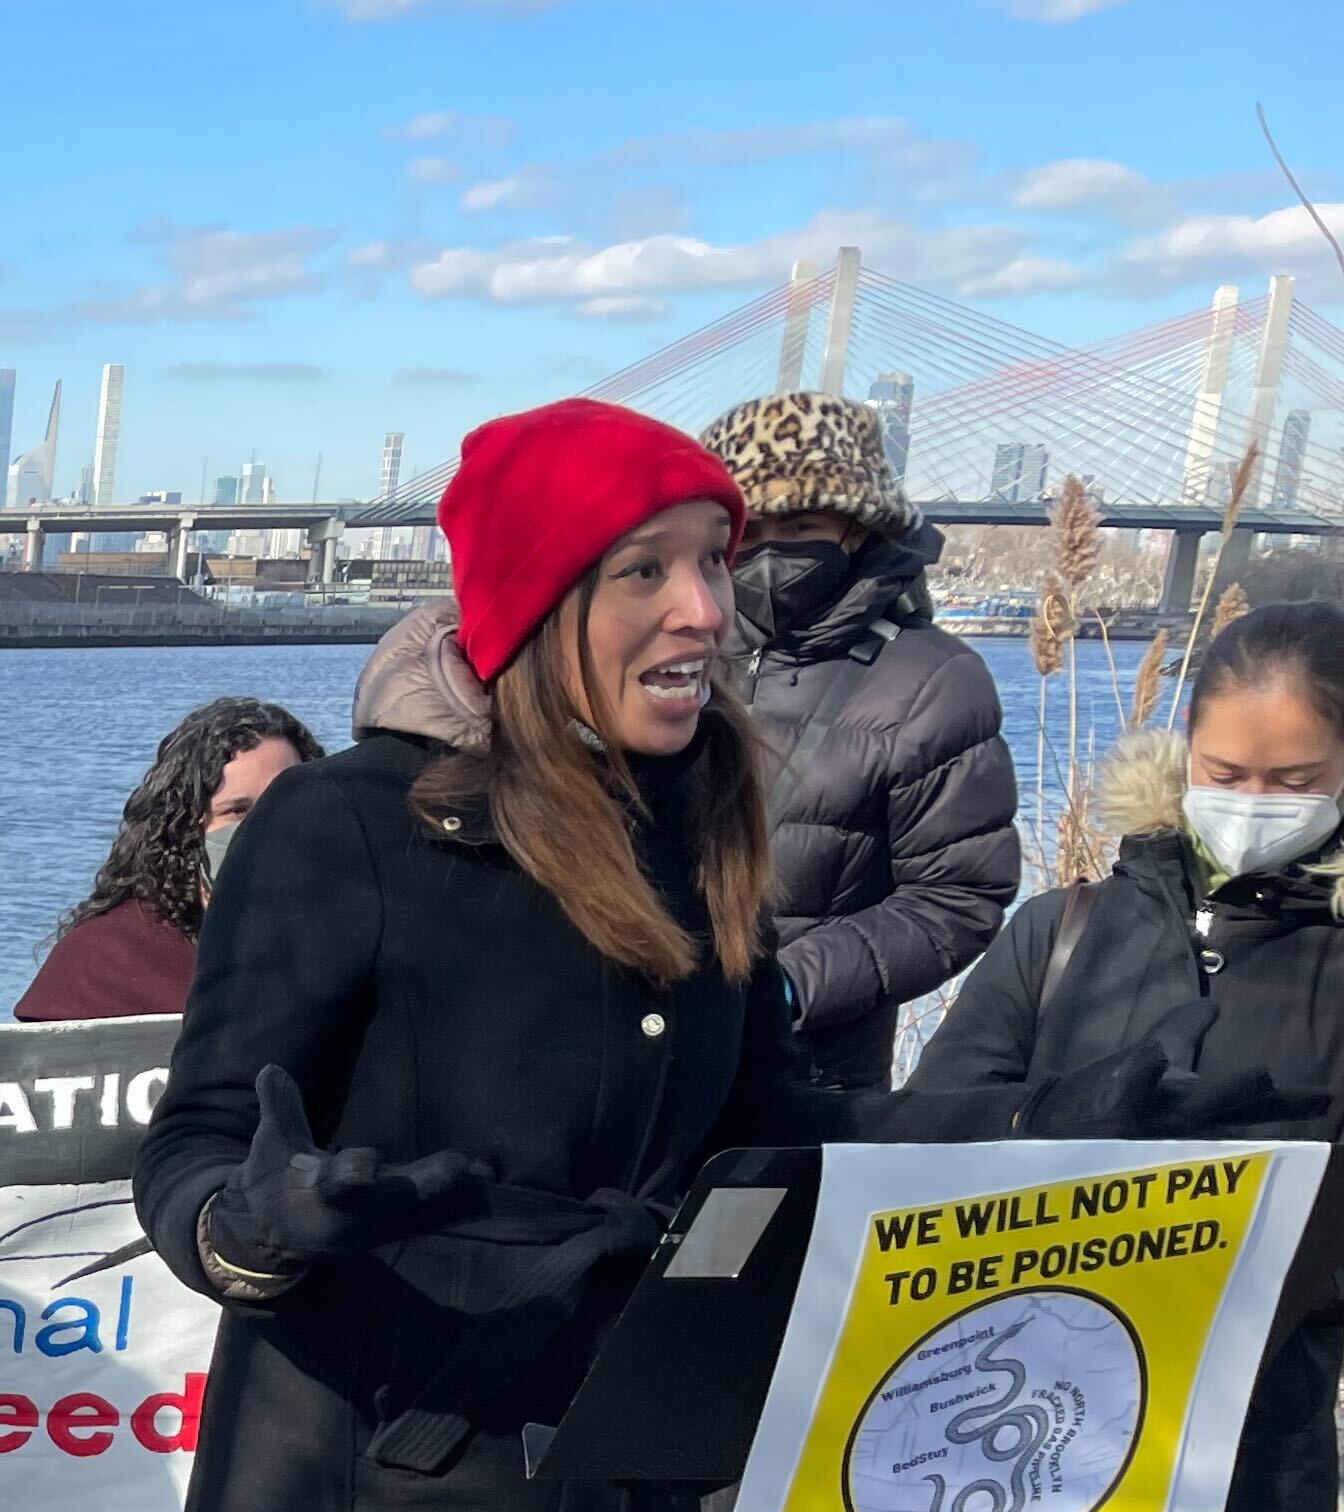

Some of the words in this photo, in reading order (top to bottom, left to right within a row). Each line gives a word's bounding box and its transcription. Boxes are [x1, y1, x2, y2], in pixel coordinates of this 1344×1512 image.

[875, 1210, 943, 1252] WE
[956, 1189, 1062, 1238] WILL
[1071, 1172, 1158, 1218] NOT
[1165, 1158, 1251, 1207] PAY
[884, 1268, 935, 1305] TO
[947, 1256, 1004, 1297] BE
[1011, 1219, 1228, 1285] POISONED.
[917, 1326, 995, 1361] Greenpoint
[881, 1364, 972, 1402] Williamsburg
[929, 1383, 997, 1413] Bushwick
